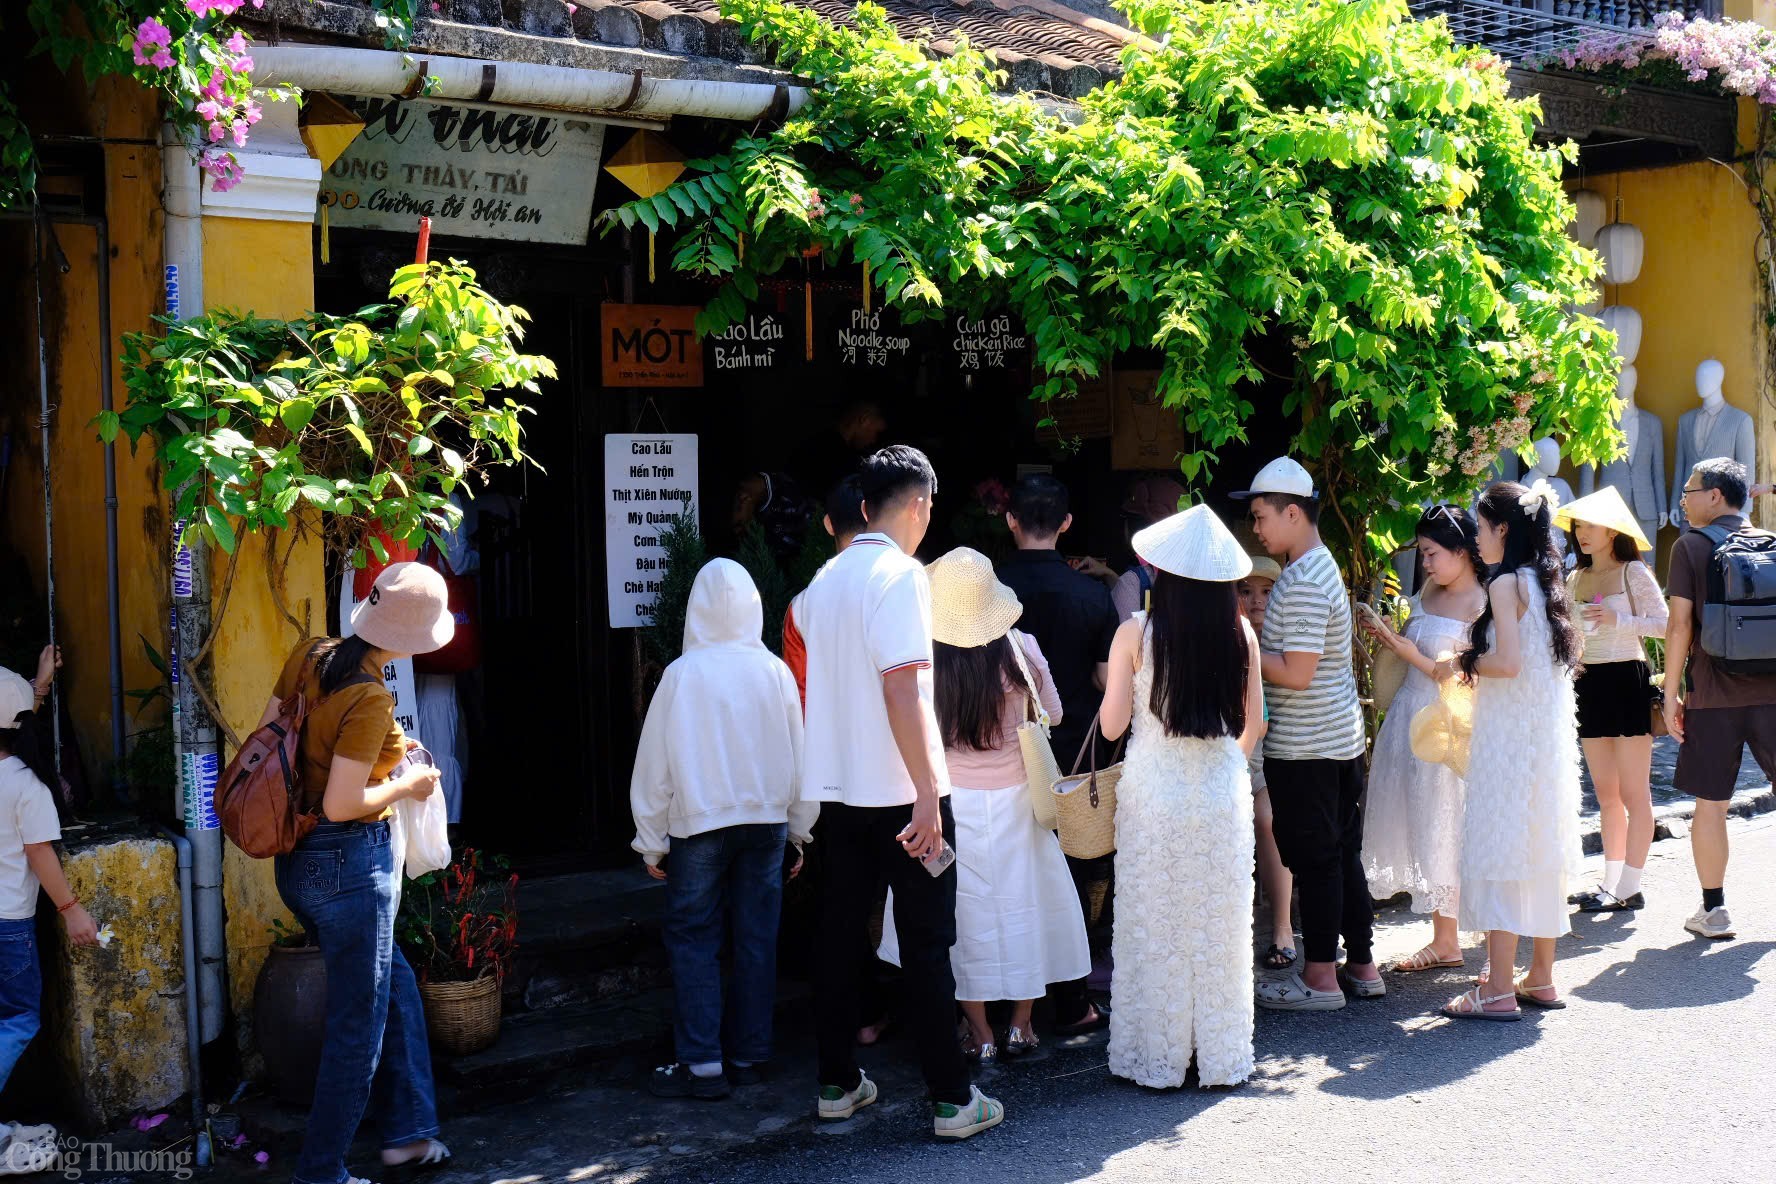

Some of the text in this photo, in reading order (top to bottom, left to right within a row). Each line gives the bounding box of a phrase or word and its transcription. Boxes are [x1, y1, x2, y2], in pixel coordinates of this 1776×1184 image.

[611, 318, 693, 364] MÓT
[838, 327, 910, 356] Noodle soup
[715, 345, 751, 369] Bánh
[632, 442, 651, 455] Cao
[629, 463, 674, 480] Hến Trộn
[612, 489, 632, 503] Thịt
[634, 488, 657, 501] Xiên
[634, 534, 657, 547] Cơm
[636, 557, 656, 572] Đậu
[624, 581, 644, 593] Chè
[384, 661, 398, 681] GÀ
